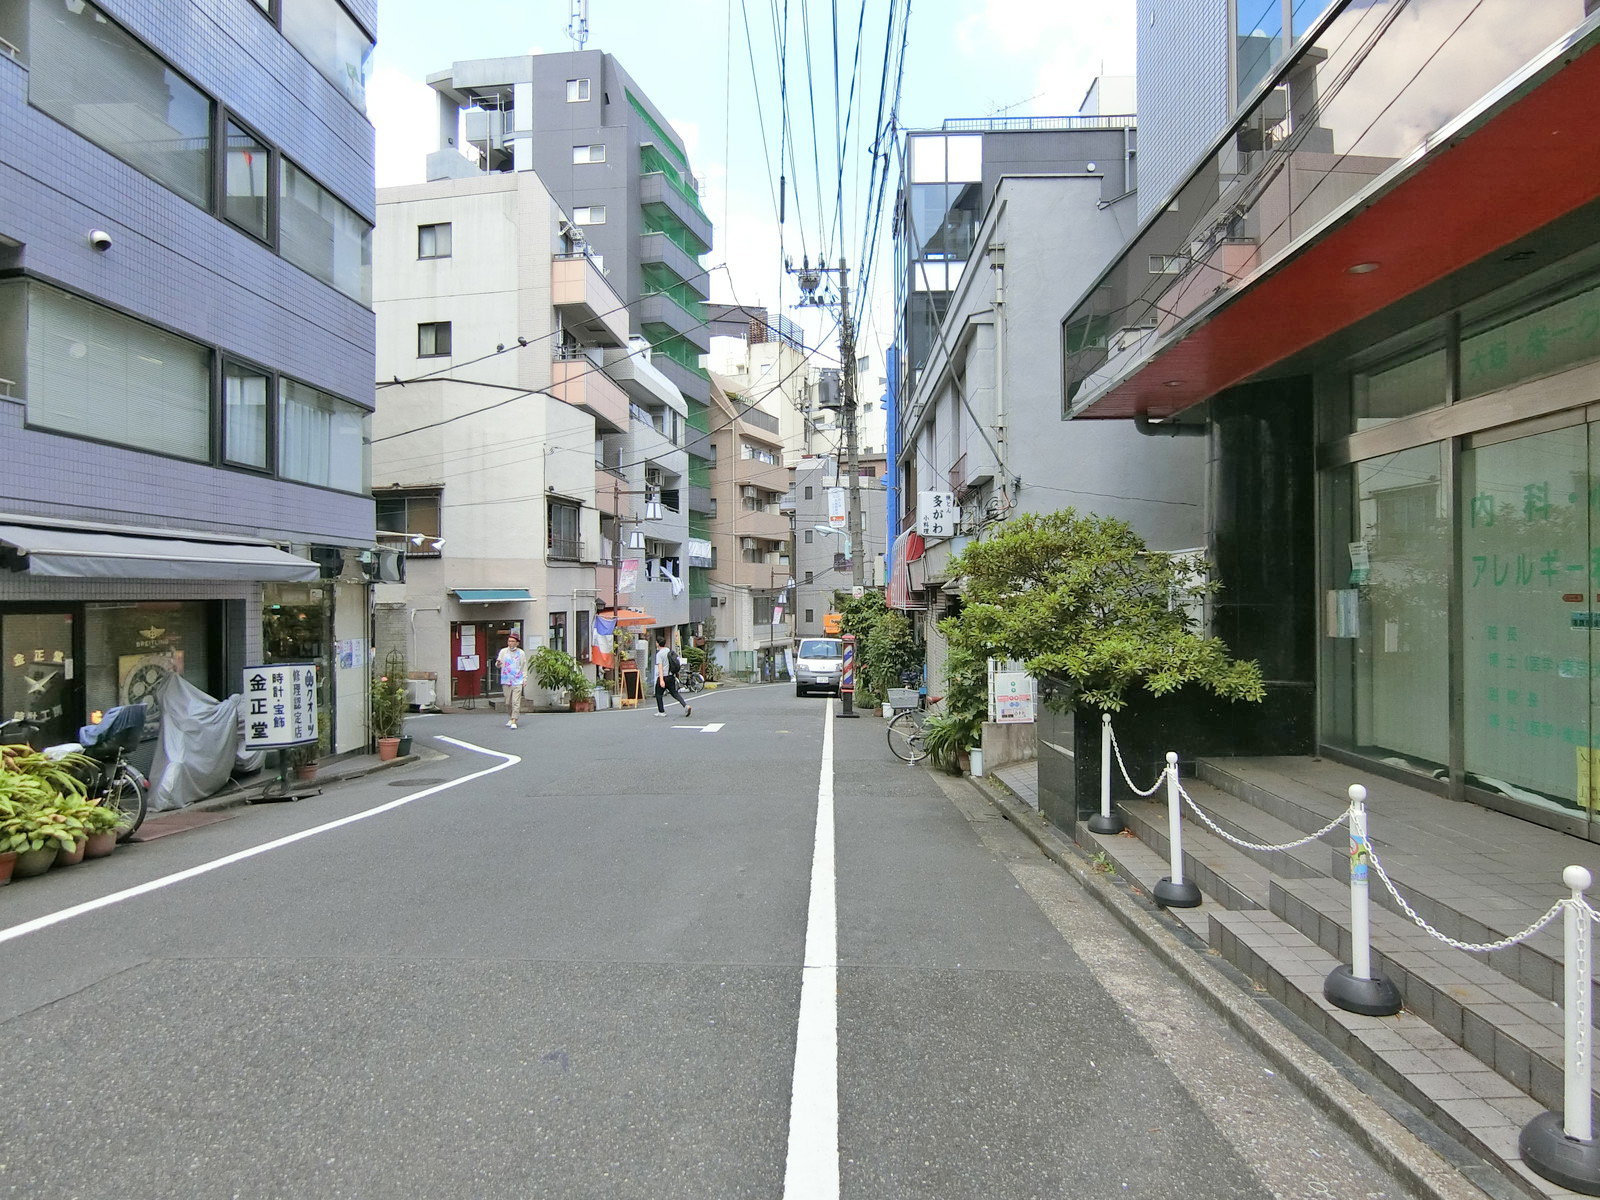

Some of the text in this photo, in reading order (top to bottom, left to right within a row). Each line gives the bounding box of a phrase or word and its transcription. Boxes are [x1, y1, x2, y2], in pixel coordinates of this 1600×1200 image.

[933, 495, 943, 534] 多がわ
[13, 649, 64, 667] 金正堂
[249, 673, 269, 739] 金正堂
[272, 672, 285, 728] 時計・宝飾
[293, 669, 302, 739] 修理認定店
